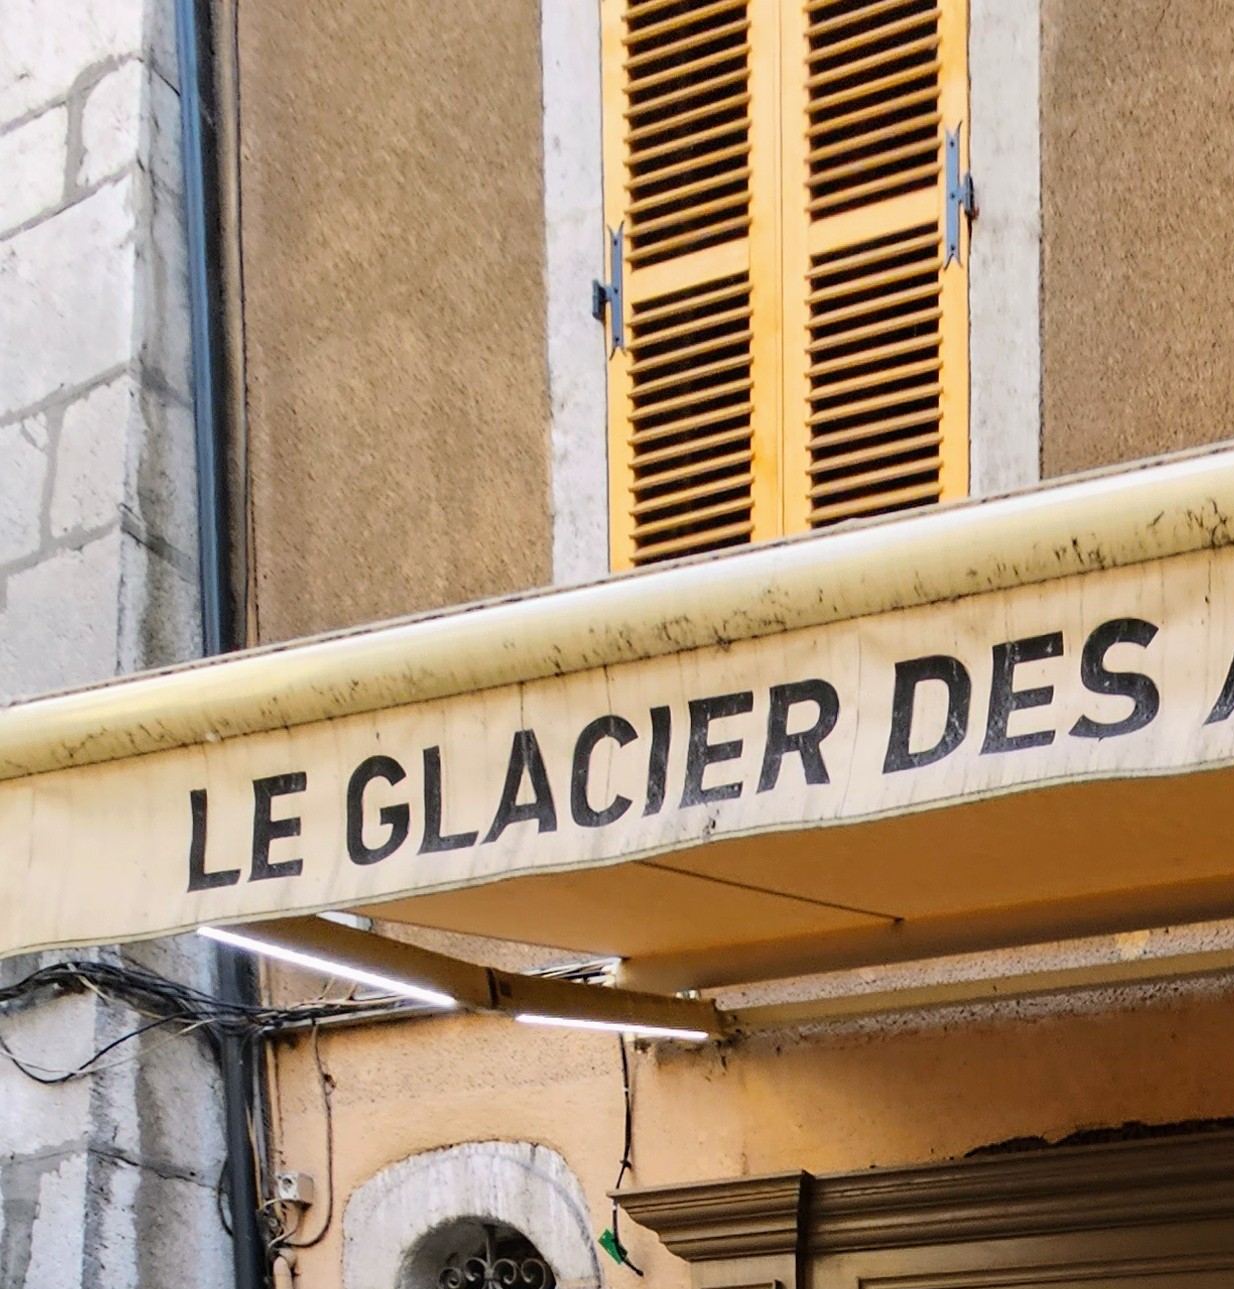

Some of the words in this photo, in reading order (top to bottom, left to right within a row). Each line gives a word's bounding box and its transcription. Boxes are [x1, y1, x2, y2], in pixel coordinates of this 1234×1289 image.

[186, 771, 308, 892] LE
[345, 678, 840, 866] GLACIER
[883, 618, 1160, 774] DES
